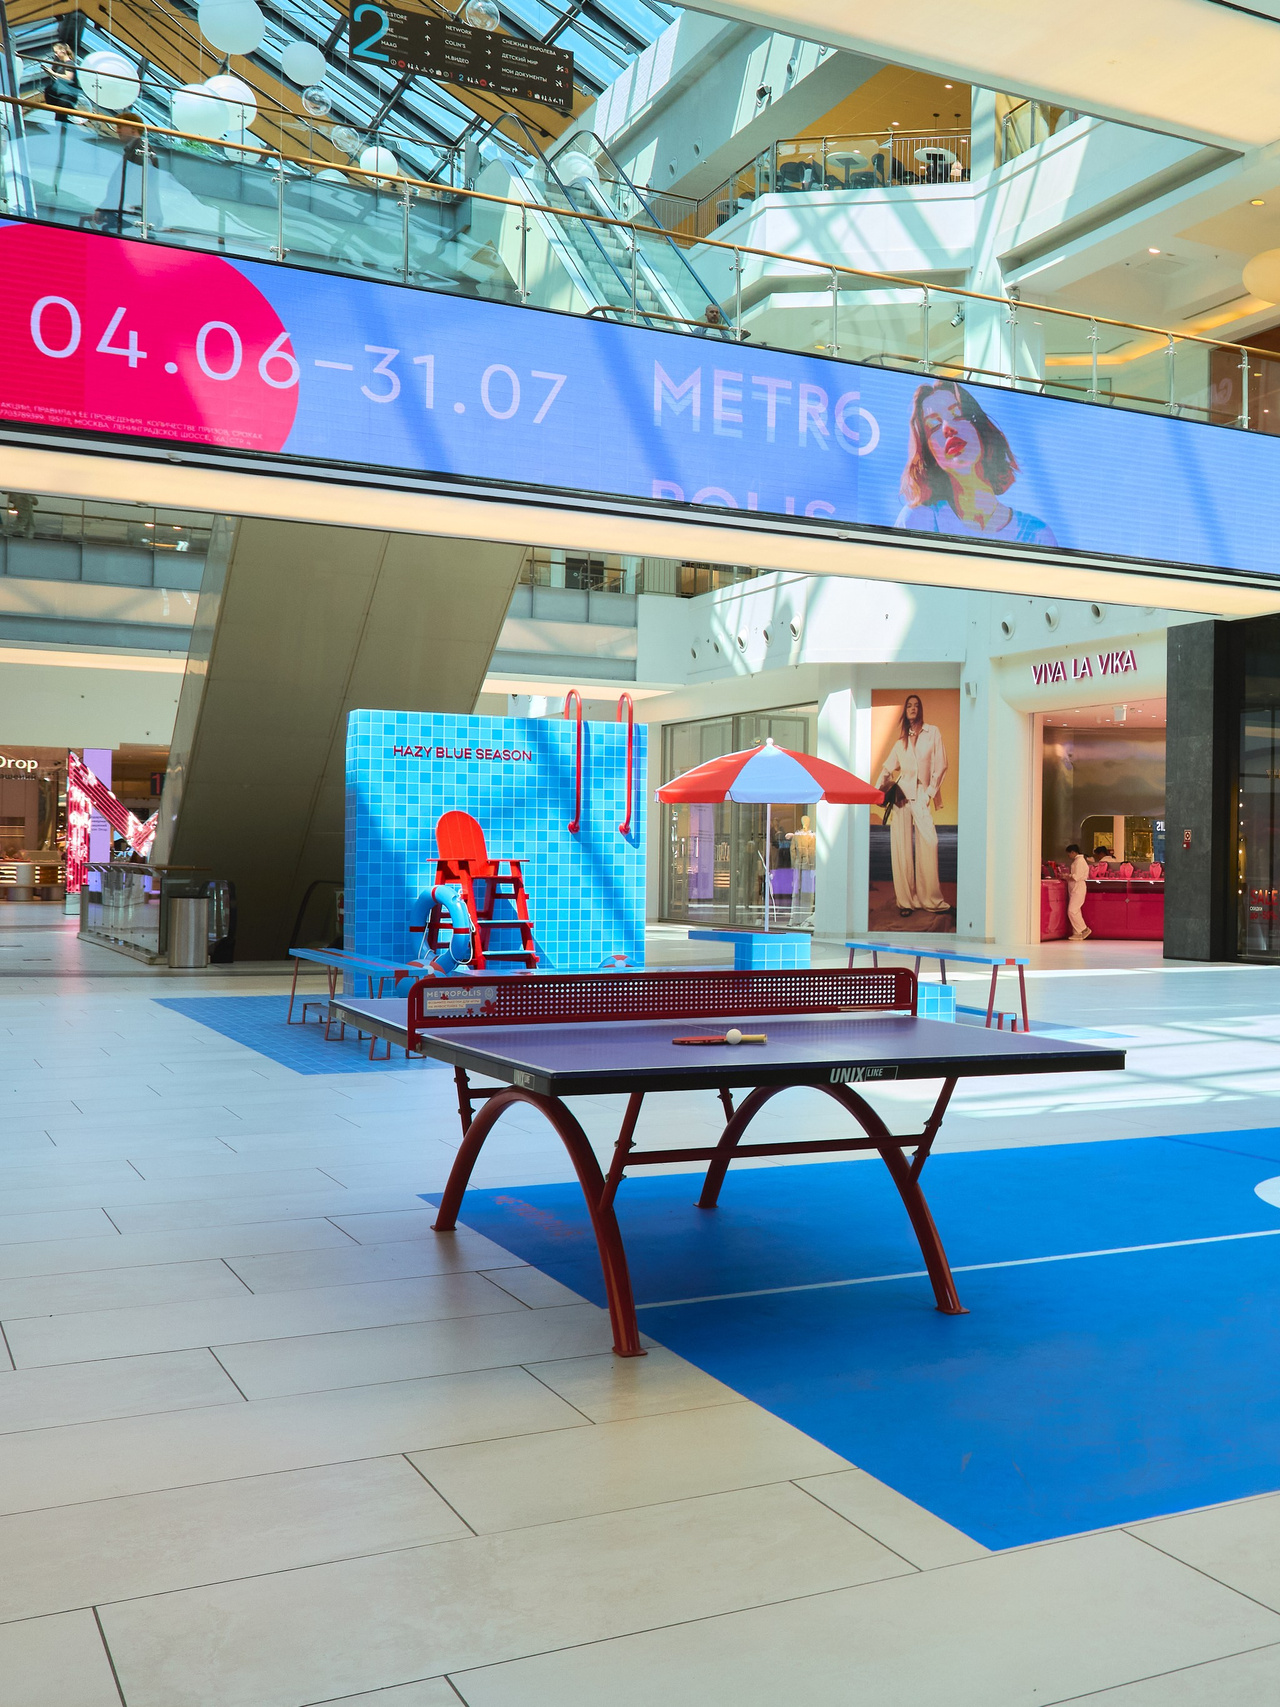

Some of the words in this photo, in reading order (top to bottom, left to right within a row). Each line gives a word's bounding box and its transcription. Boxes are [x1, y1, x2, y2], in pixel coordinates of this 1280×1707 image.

[353, 3, 389, 62] 2
[445, 25, 472, 36] NETWORK
[445, 39, 466, 49] COLIN'S
[501, 38, 528, 49] СНЕЖНАЯ
[529, 45, 557, 56] КОРОЛЕВА
[501, 52, 526, 63] ДЕТСКИЙ
[501, 67, 514, 75] МОИ
[514, 71, 548, 83] ДОКУМЕНТЫ
[653, 360, 881, 457] METRO
[1031, 661, 1067, 685] VIVA
[1071, 656, 1093, 679] LA
[1096, 649, 1138, 675] VIKA
[393, 745, 432, 758] HAZY
[435, 746, 472, 759] BLUE
[475, 748, 533, 761] SEASON
[1251, 889, 1279, 906] SALE
[426, 989, 482, 998] METROPOLIS
[829, 1066, 866, 1084] UNIX
[867, 1068, 884, 1077] LINE
